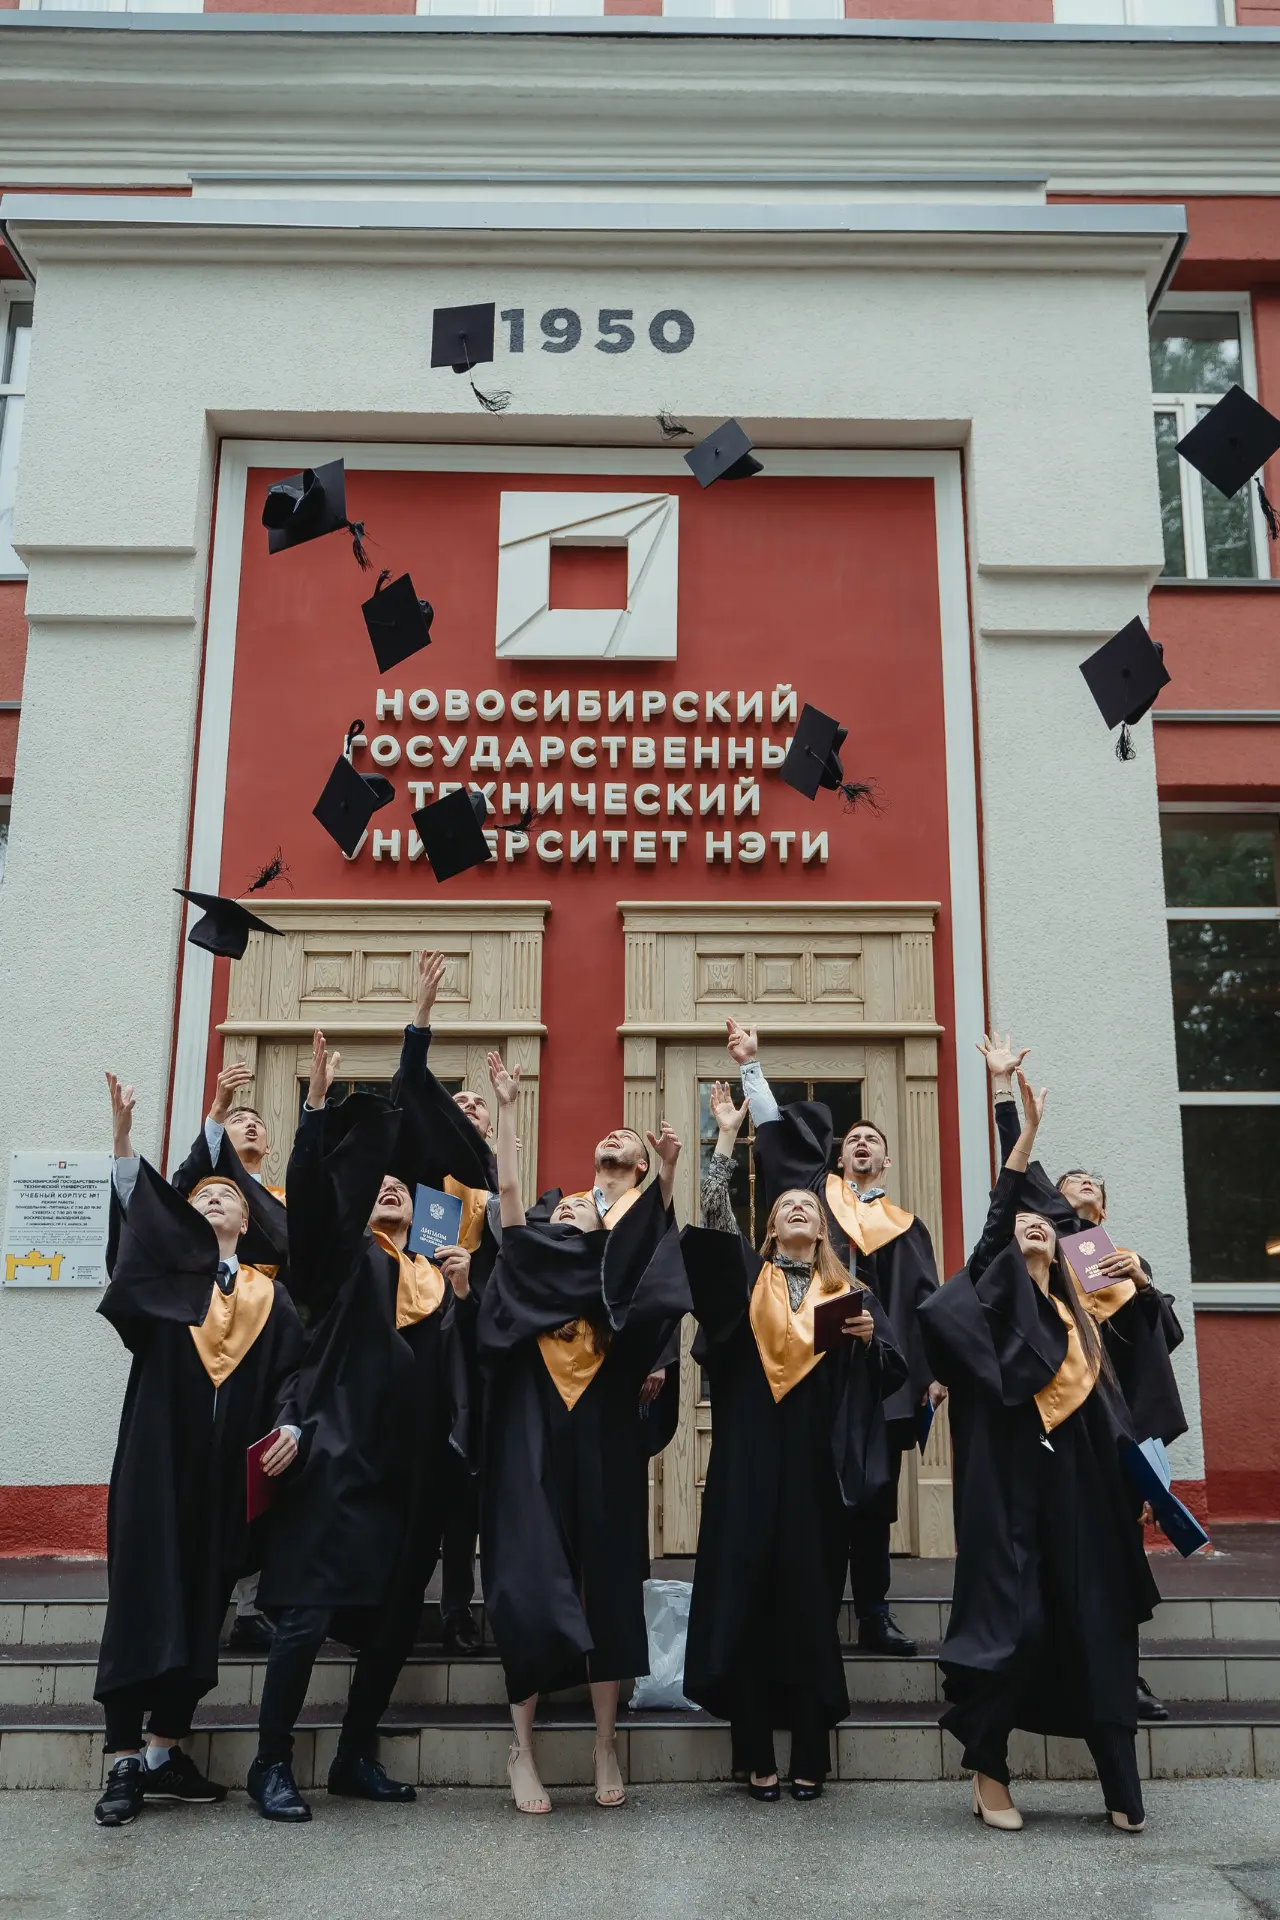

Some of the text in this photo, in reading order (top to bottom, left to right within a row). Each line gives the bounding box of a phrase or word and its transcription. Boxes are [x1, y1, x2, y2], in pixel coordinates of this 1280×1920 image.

[500, 308, 695, 354] 1950
[376, 684, 798, 723] НОВОСИБИРСКИЙ
[343, 734, 794, 772] ГОСУДАРСТВЕННЫ
[342, 829, 829, 863] НИРСИТЕТ НЭТИ
